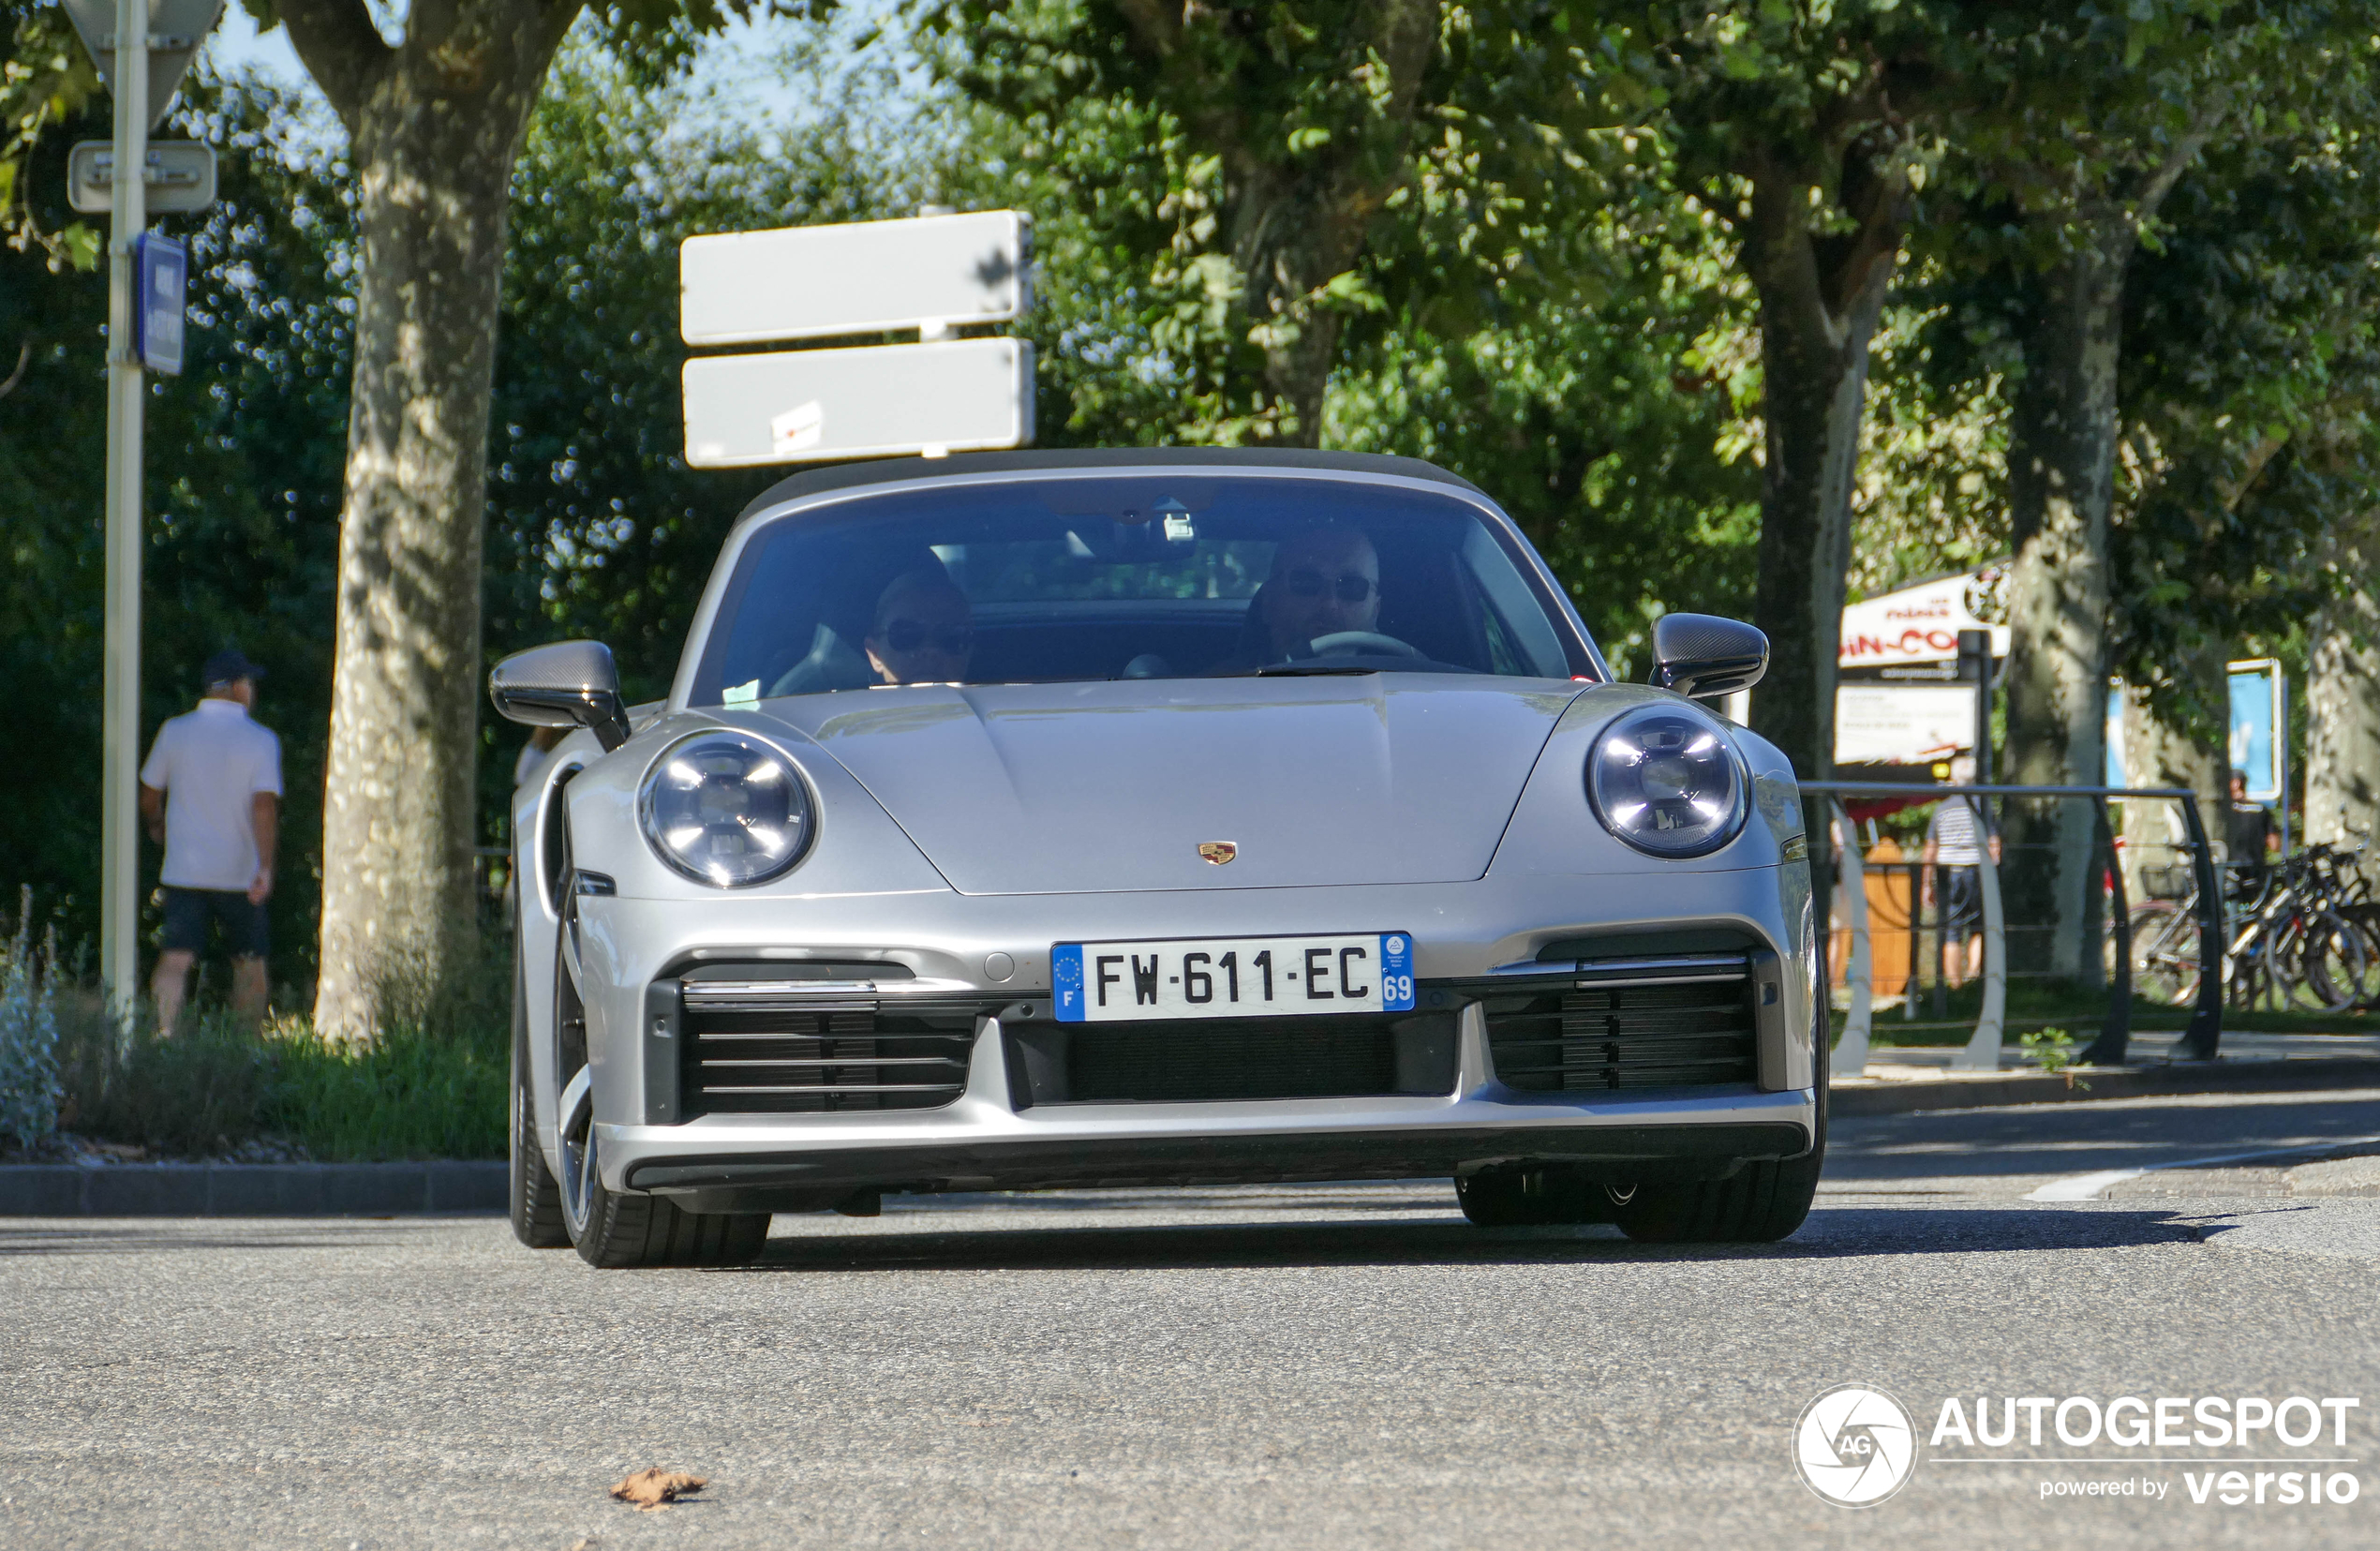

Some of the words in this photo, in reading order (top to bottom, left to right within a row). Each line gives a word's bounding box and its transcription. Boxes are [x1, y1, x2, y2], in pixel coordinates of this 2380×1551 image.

[1096, 947, 1369, 1007] FW-611-EC
[1383, 976, 1411, 1001] 69
[1064, 991, 1074, 1007] F
